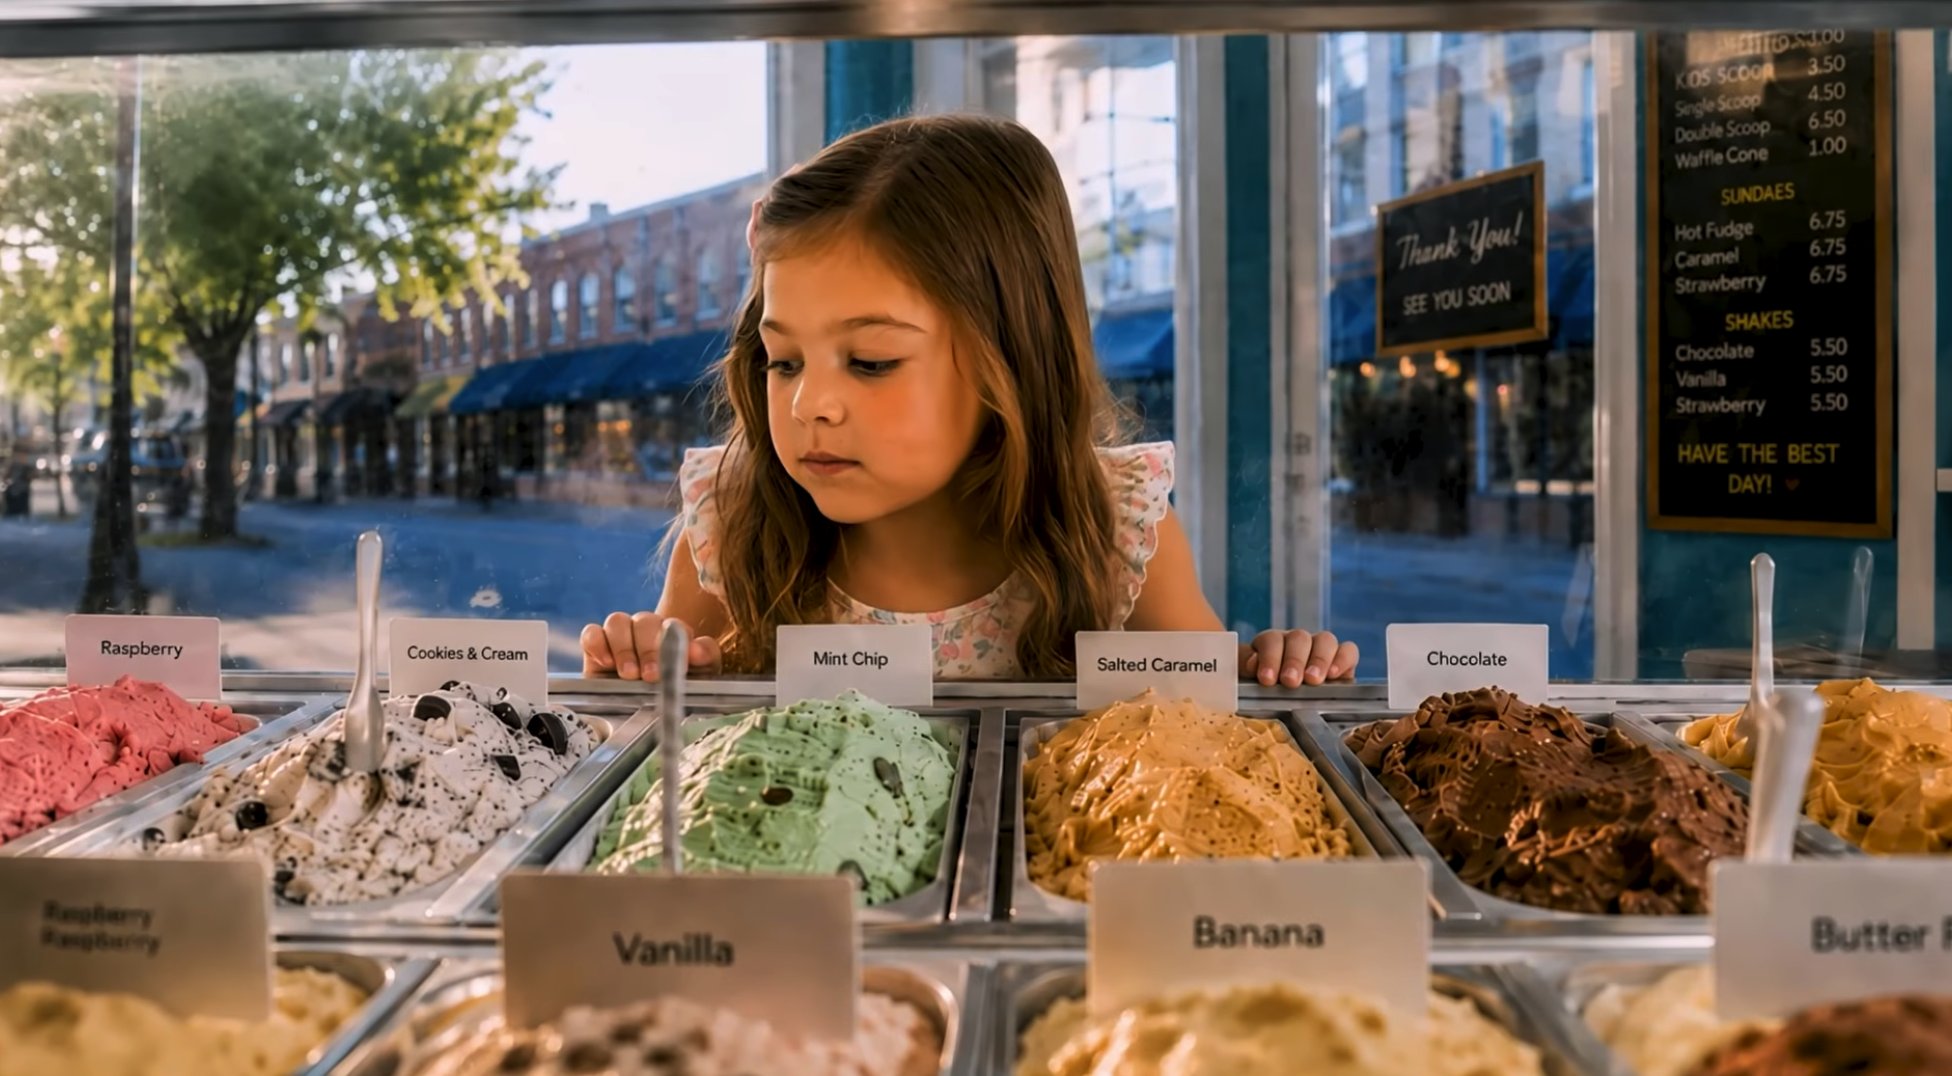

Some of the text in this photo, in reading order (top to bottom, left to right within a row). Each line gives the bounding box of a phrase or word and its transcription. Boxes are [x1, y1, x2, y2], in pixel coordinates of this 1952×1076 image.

[1808, 55, 1845, 76] 3.50
[1675, 82, 1845, 119] Single Scoop 4.50
[1675, 109, 1845, 144] Double Scoop 6.50
[1675, 137, 1846, 169] Waffle Cone 1.00
[1721, 182, 1795, 205] SUNDAES
[1675, 210, 1846, 244] Hot Fudge 6.75
[1397, 210, 1524, 270] Thank You!
[1675, 238, 1846, 269] Caramel 6.75
[1675, 265, 1847, 295] Strawberry 6.75
[1403, 281, 1511, 316] SEE YOU SOON
[1725, 311, 1794, 331] SHAKES
[1675, 337, 1848, 362] Chocolate 5.50
[1675, 365, 1848, 388] Vanilla 5.50
[1675, 393, 1848, 417] Strawberry 5.50
[1678, 443, 1840, 464] HAVE THE BEST
[1728, 474, 1772, 494] DAY!
[101, 640, 183, 660] Raspberry
[407, 645, 528, 662] Cookies & Cream
[813, 651, 889, 670] Mint Chip
[1427, 651, 1507, 667] Chocolate
[1097, 657, 1217, 673] Salted Caramel
[1193, 915, 1325, 949] Banana
[1811, 915, 1932, 954] Butter
[612, 932, 735, 967] Vanilla
